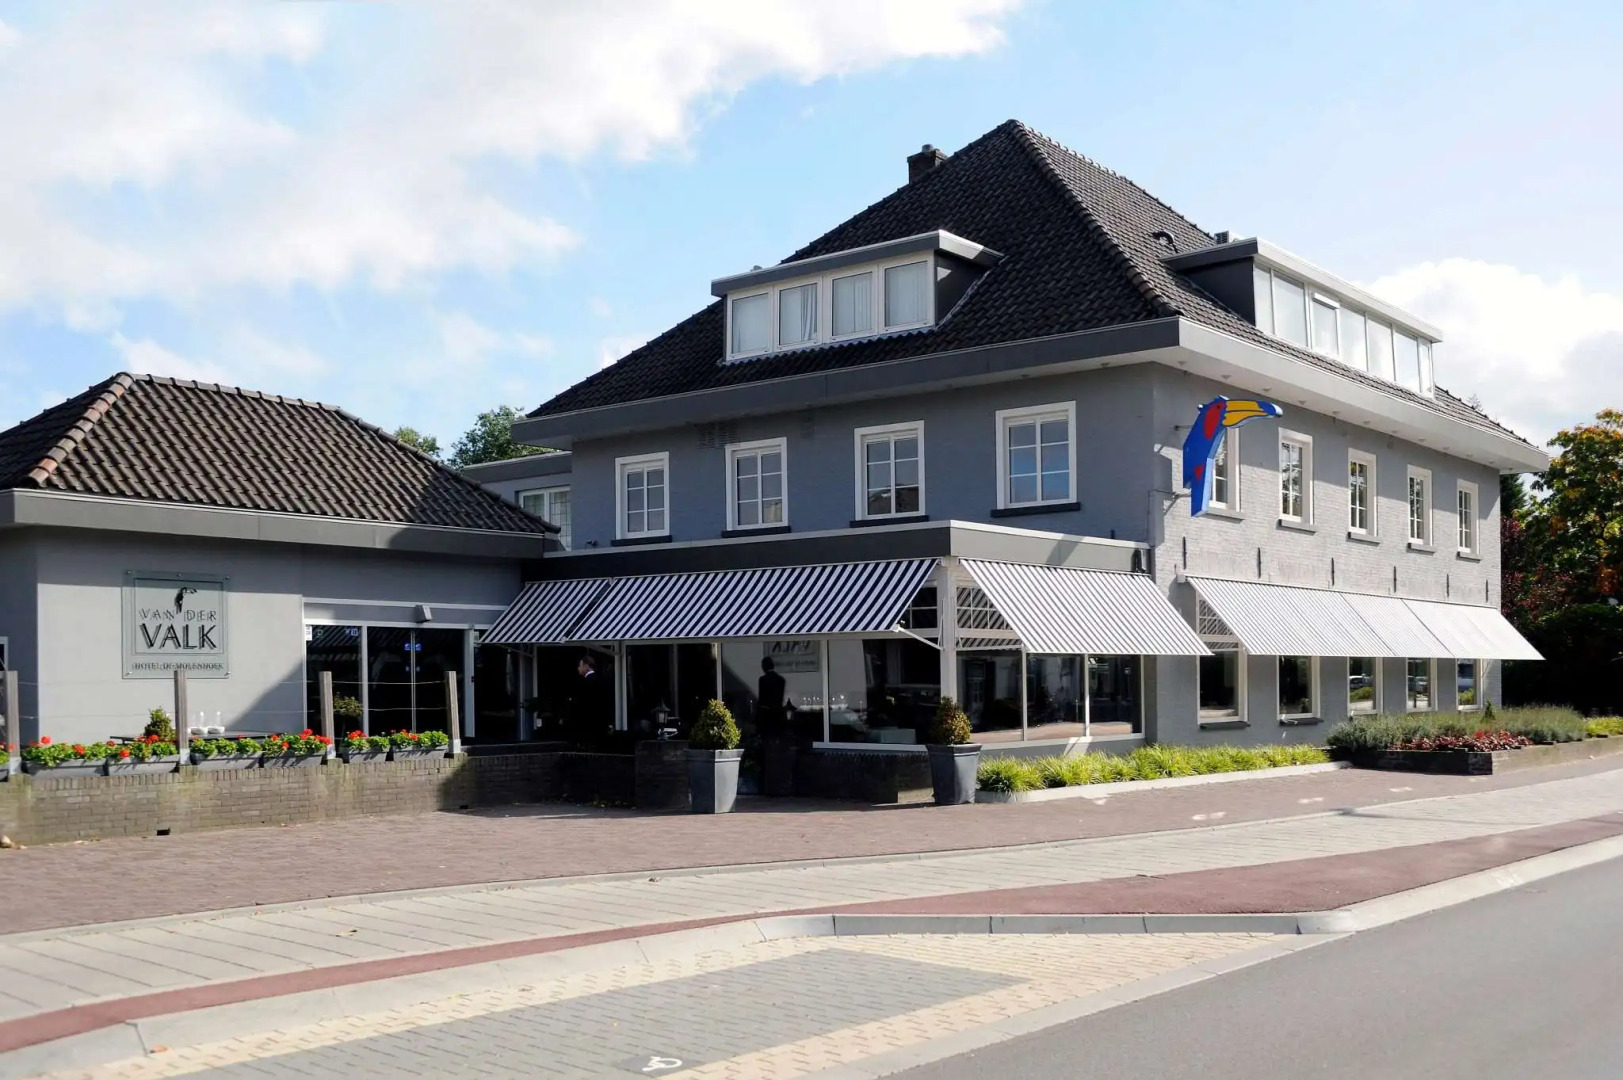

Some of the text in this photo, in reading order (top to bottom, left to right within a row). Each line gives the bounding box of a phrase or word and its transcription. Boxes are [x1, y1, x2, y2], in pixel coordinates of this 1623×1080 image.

[139, 608, 217, 621] VAN DER
[140, 622, 217, 649] VALK
[133, 662, 161, 670] HOTEL
[162, 662, 174, 670] DE
